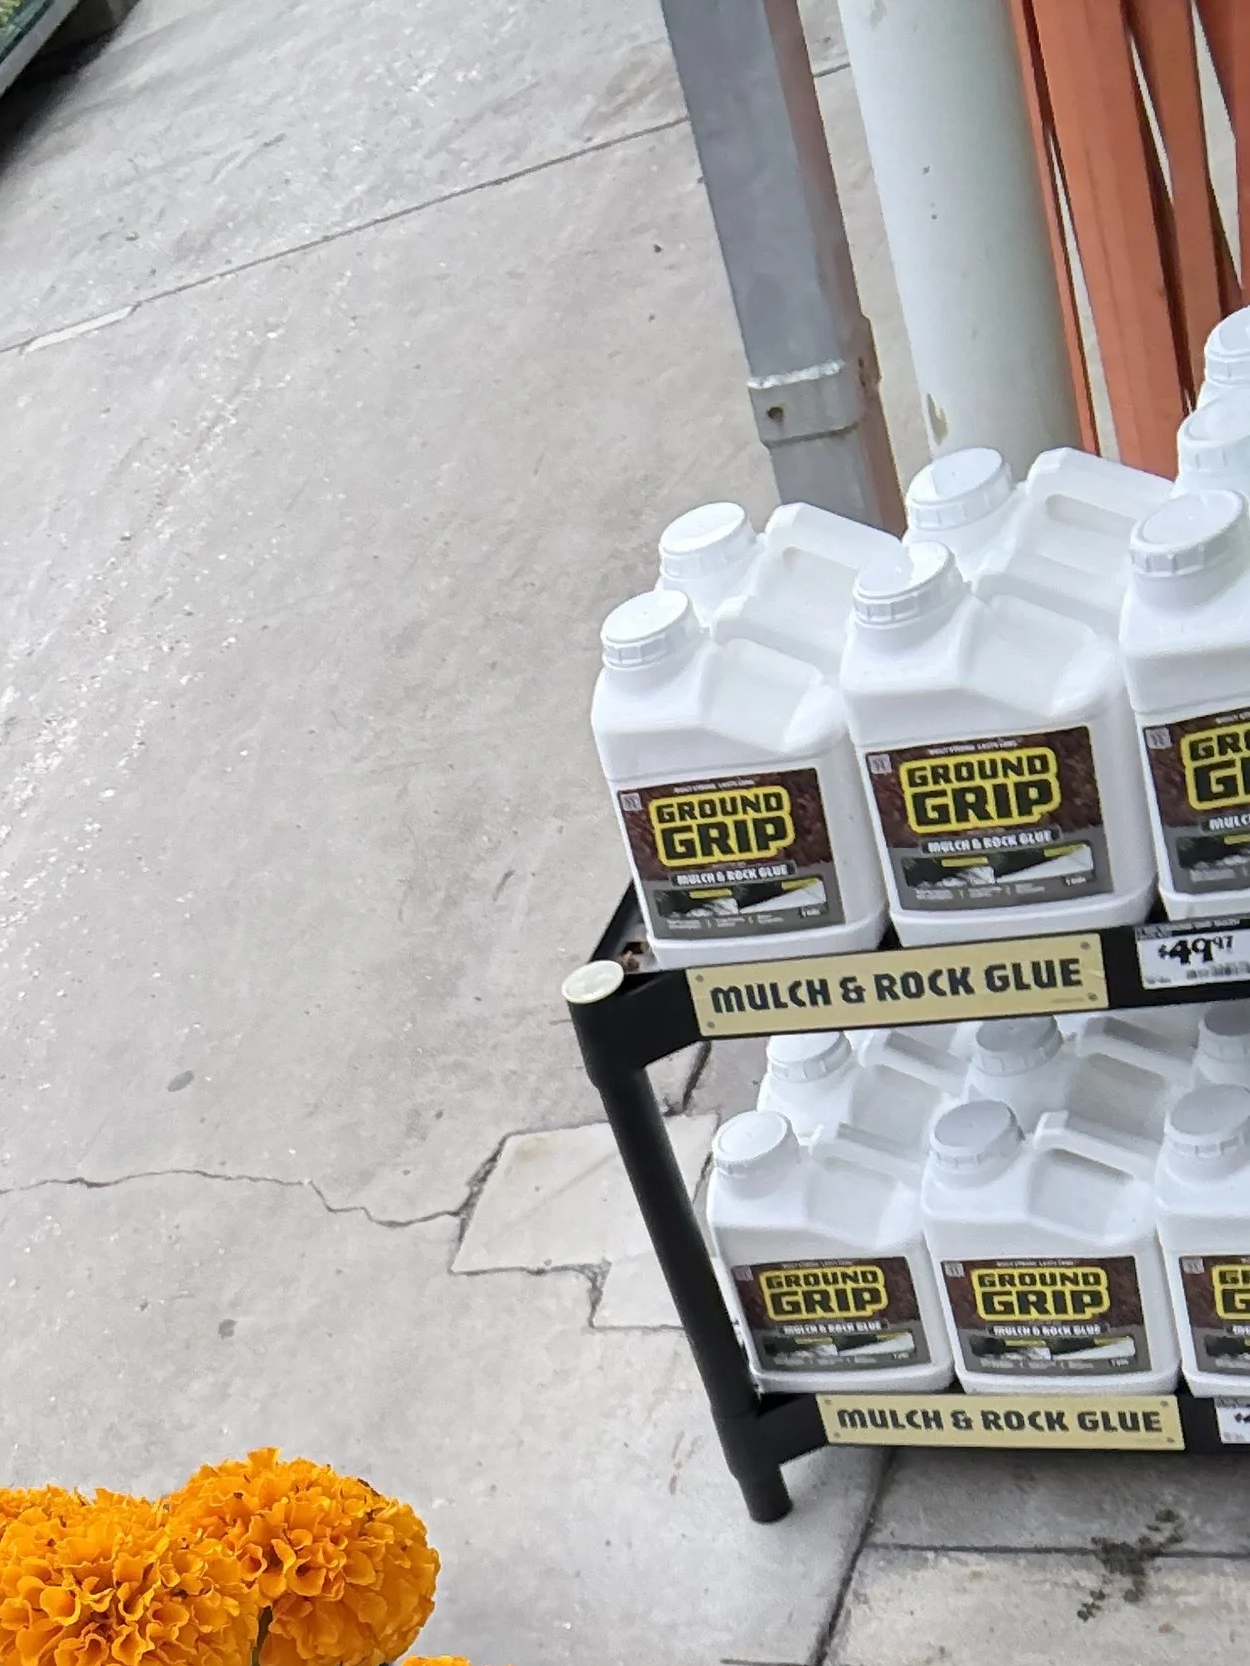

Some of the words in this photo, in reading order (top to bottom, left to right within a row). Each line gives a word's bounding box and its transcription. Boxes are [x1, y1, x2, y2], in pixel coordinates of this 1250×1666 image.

[907, 754, 1050, 788] GROUND
[656, 792, 784, 823] GROUND
[911, 779, 1052, 826] GRIP
[661, 816, 788, 860] GRIP
[983, 834, 1017, 848] ROCK
[726, 868, 757, 881] ROCK
[711, 978, 831, 1014] MULCH
[840, 976, 866, 1004] &
[873, 967, 975, 1001] ROCK
[985, 958, 1082, 993] GLUE
[766, 1270, 879, 1289] GROUND
[978, 1271, 1101, 1288] GROUND
[771, 1287, 882, 1315] GRIP
[982, 1290, 1103, 1316] GRIP
[838, 1408, 944, 1431] MULCH
[951, 1410, 974, 1431] &
[981, 1409, 1069, 1432] ROCK
[1077, 1411, 1162, 1433] GLUE
